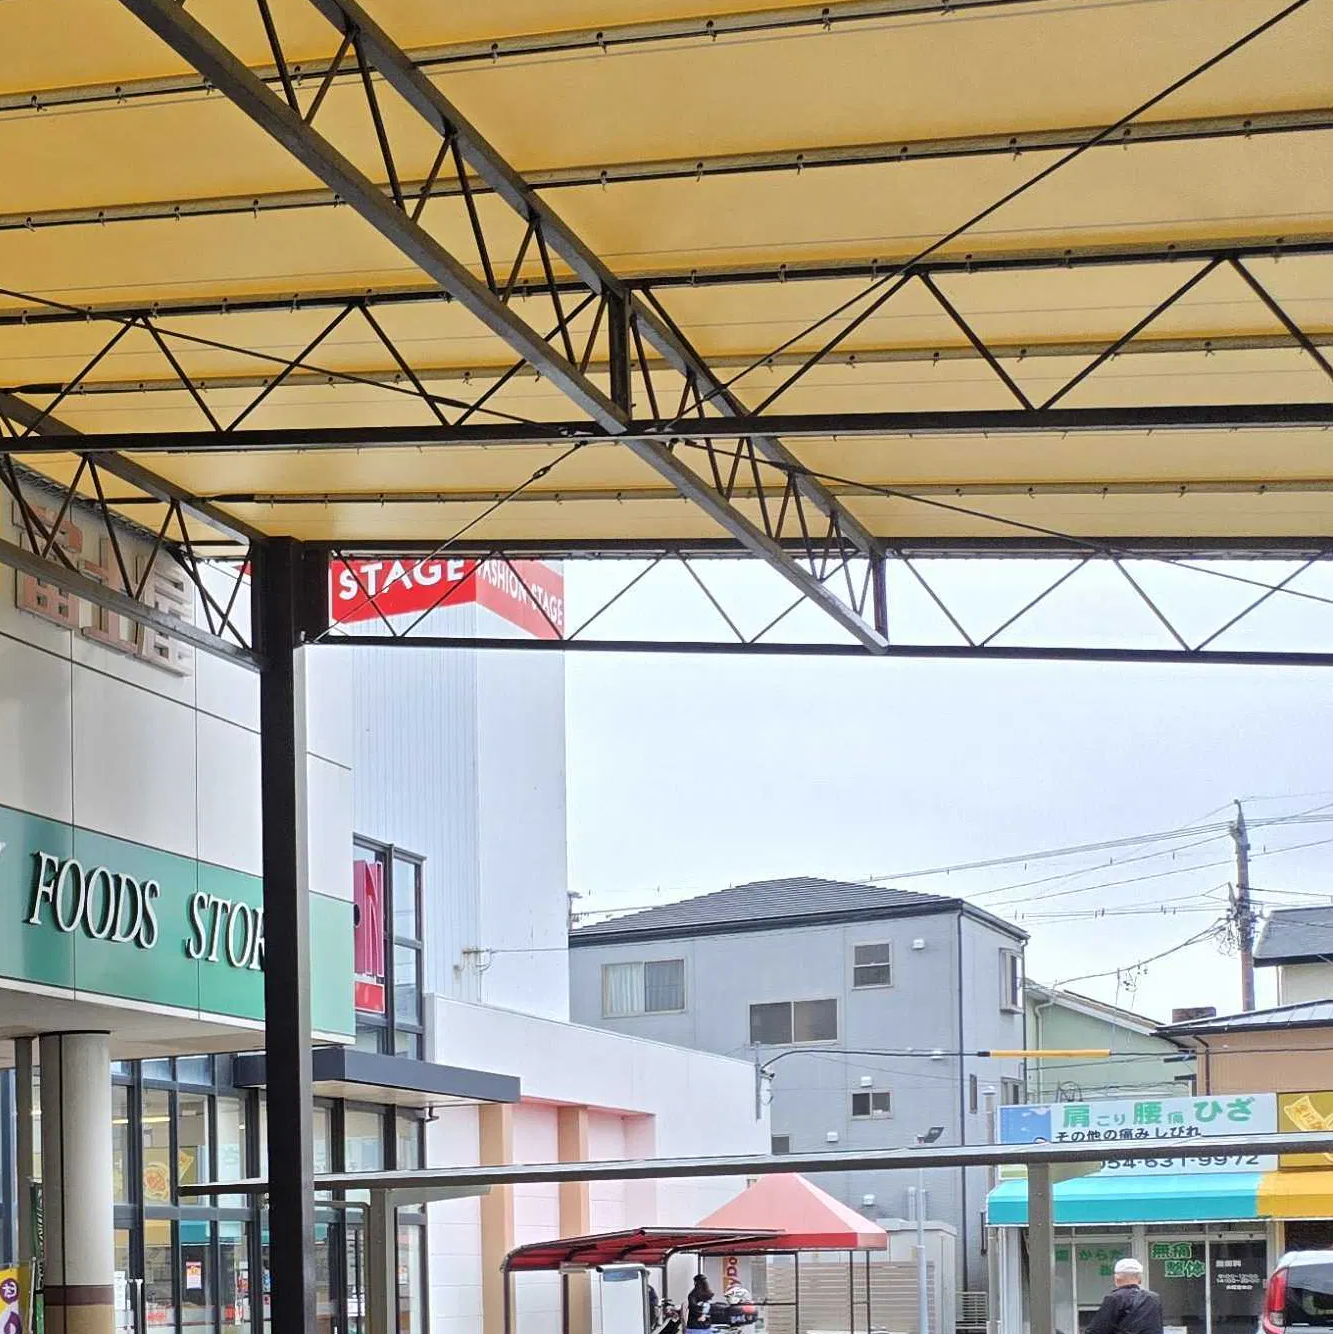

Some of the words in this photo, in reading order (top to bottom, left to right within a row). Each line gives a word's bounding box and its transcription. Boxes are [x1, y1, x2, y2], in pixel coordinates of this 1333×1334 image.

[339, 560, 465, 600] STAGE
[531, 584, 564, 627] STAGE
[23, 850, 161, 950] FOODS
[184, 891, 265, 973] STOR
[1194, 1097, 1256, 1122] ひざ
[1101, 1154, 1260, 1169] 54-631-9972
